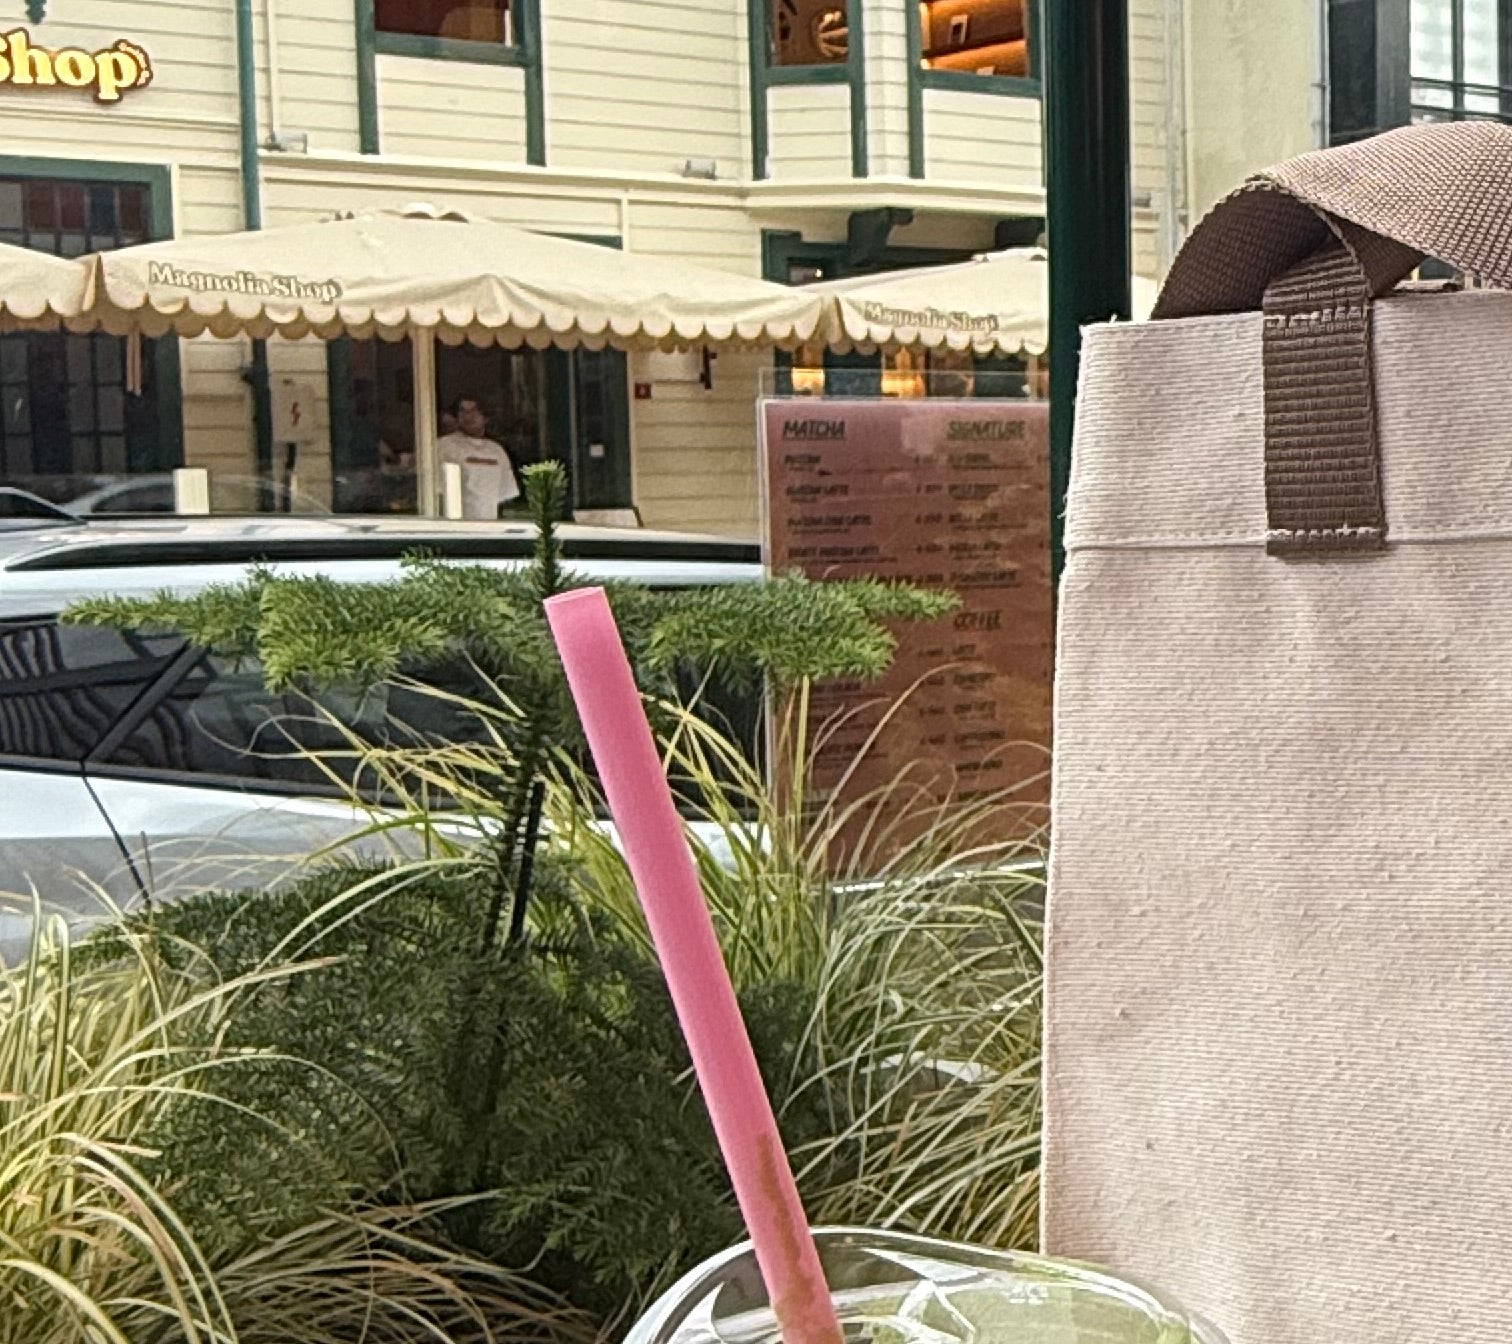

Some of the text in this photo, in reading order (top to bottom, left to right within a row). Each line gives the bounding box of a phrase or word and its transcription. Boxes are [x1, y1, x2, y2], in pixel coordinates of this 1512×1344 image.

[149, 260, 343, 305] Magnolia Shop
[783, 420, 846, 439] MATCHA
[948, 420, 1026, 439] SIGNATURE
